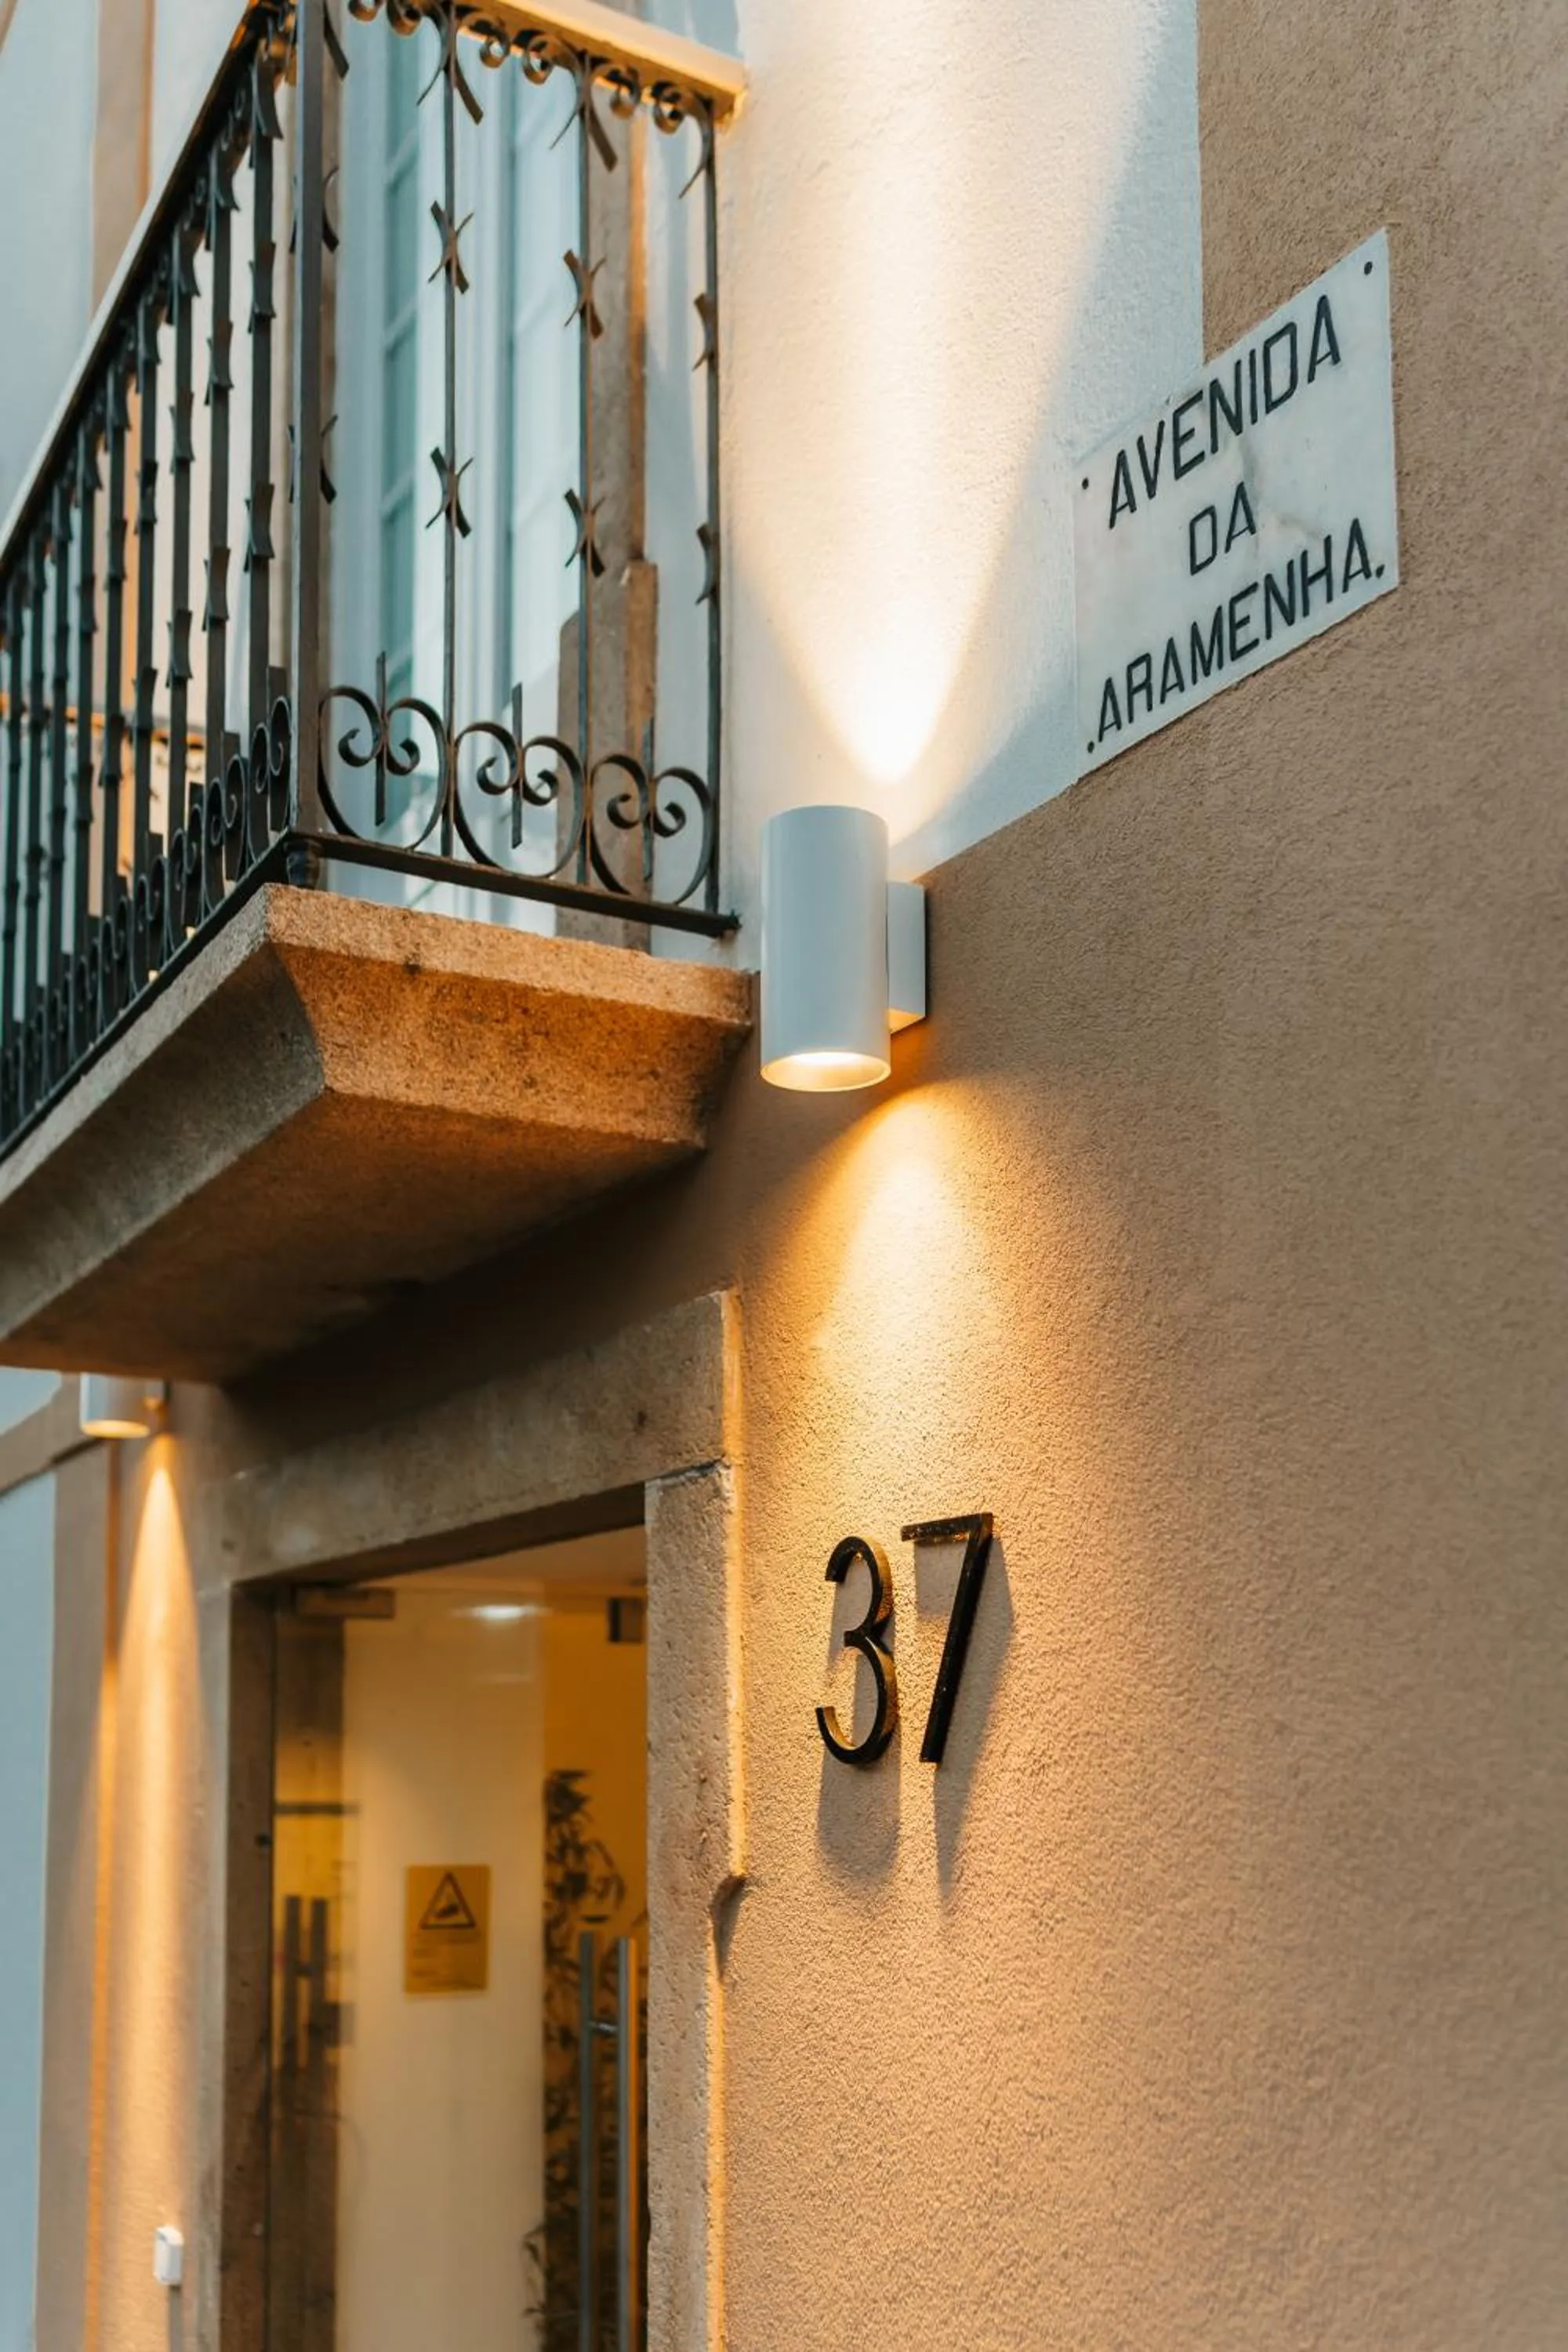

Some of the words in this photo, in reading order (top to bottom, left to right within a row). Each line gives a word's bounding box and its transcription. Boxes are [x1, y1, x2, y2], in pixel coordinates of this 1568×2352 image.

[1109, 295, 1341, 529] AVENIDA
[1189, 481, 1257, 575] DA
[816, 1512, 993, 1766] 37
